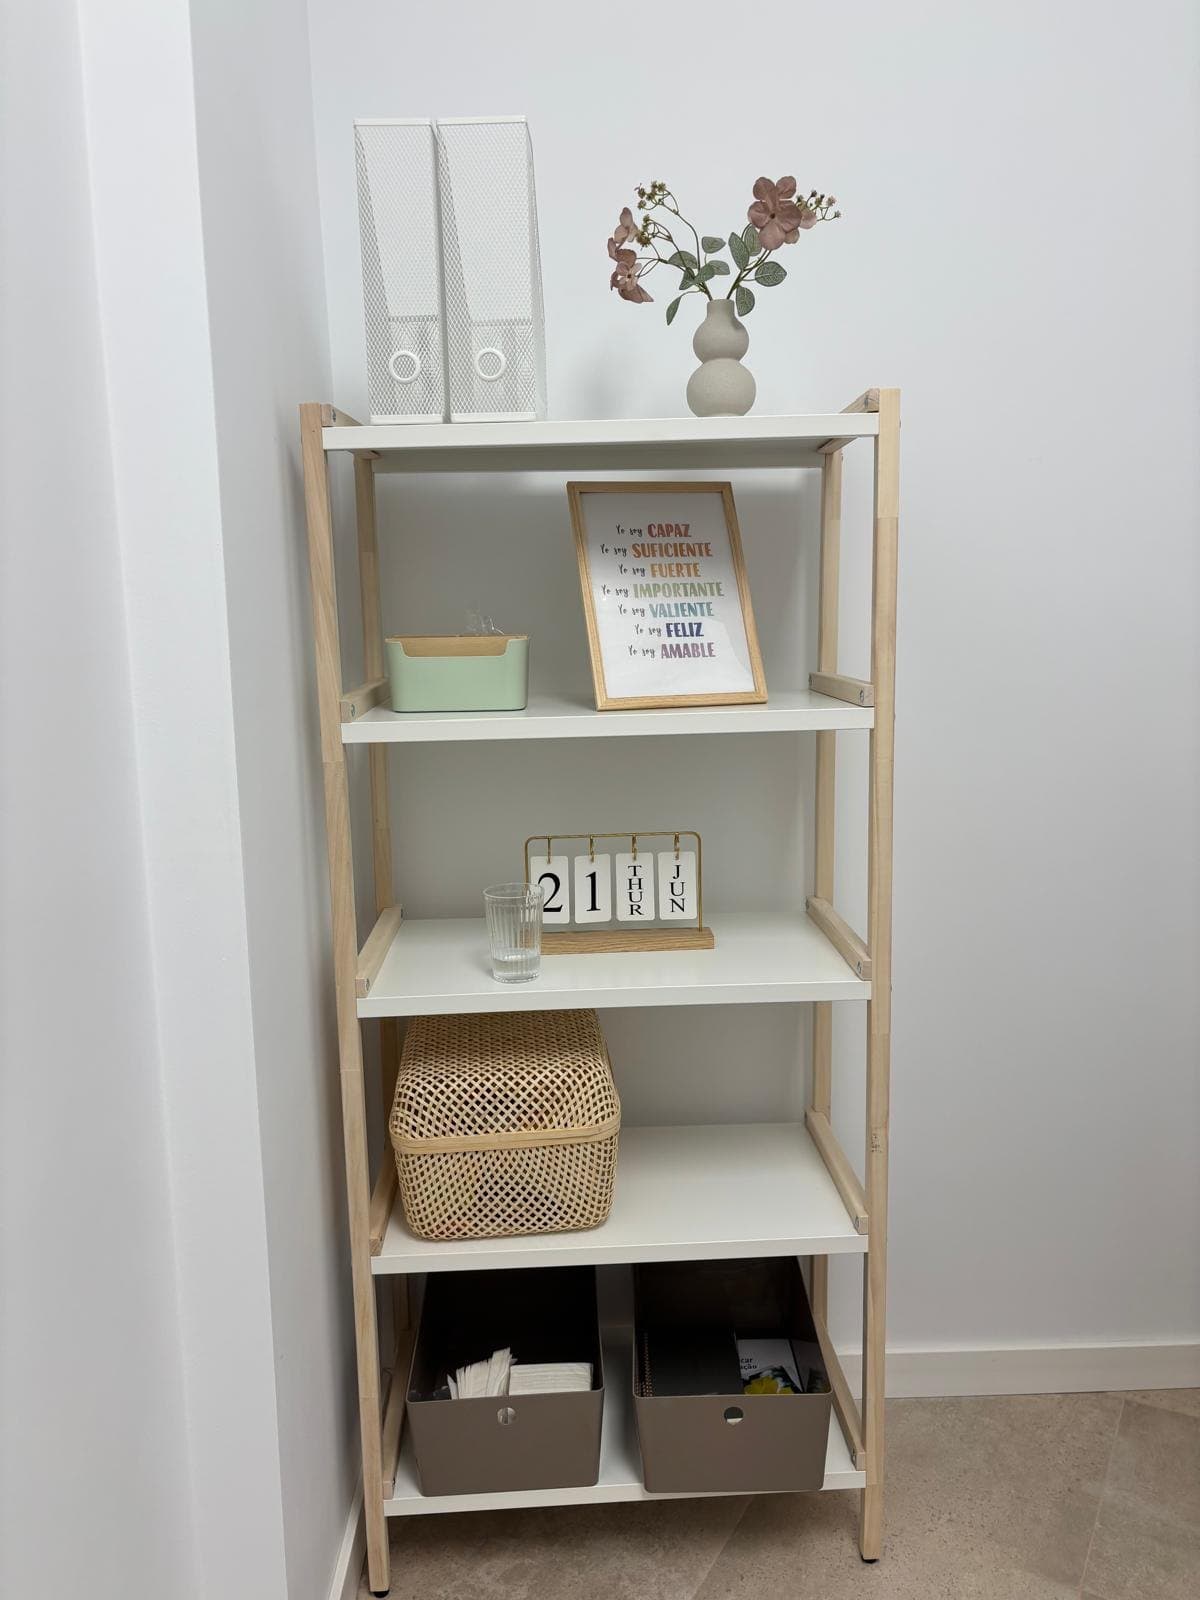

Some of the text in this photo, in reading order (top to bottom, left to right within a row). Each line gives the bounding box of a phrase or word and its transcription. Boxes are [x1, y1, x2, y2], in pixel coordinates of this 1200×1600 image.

[616, 524, 691, 538] Yo soy CAPAZ
[600, 543, 713, 558] Yo soy SUFICIENTE
[618, 563, 701, 578] Yo soy FUERTE
[602, 582, 724, 599] Yo soy IMPORTANTE
[618, 602, 715, 618] Yo soy VALIENTE
[634, 622, 704, 638] Yo soy FELIZ
[628, 642, 716, 659] Yo soy AMABLE
[627, 865, 644, 916] THUR
[669, 864, 685, 913] JUN
